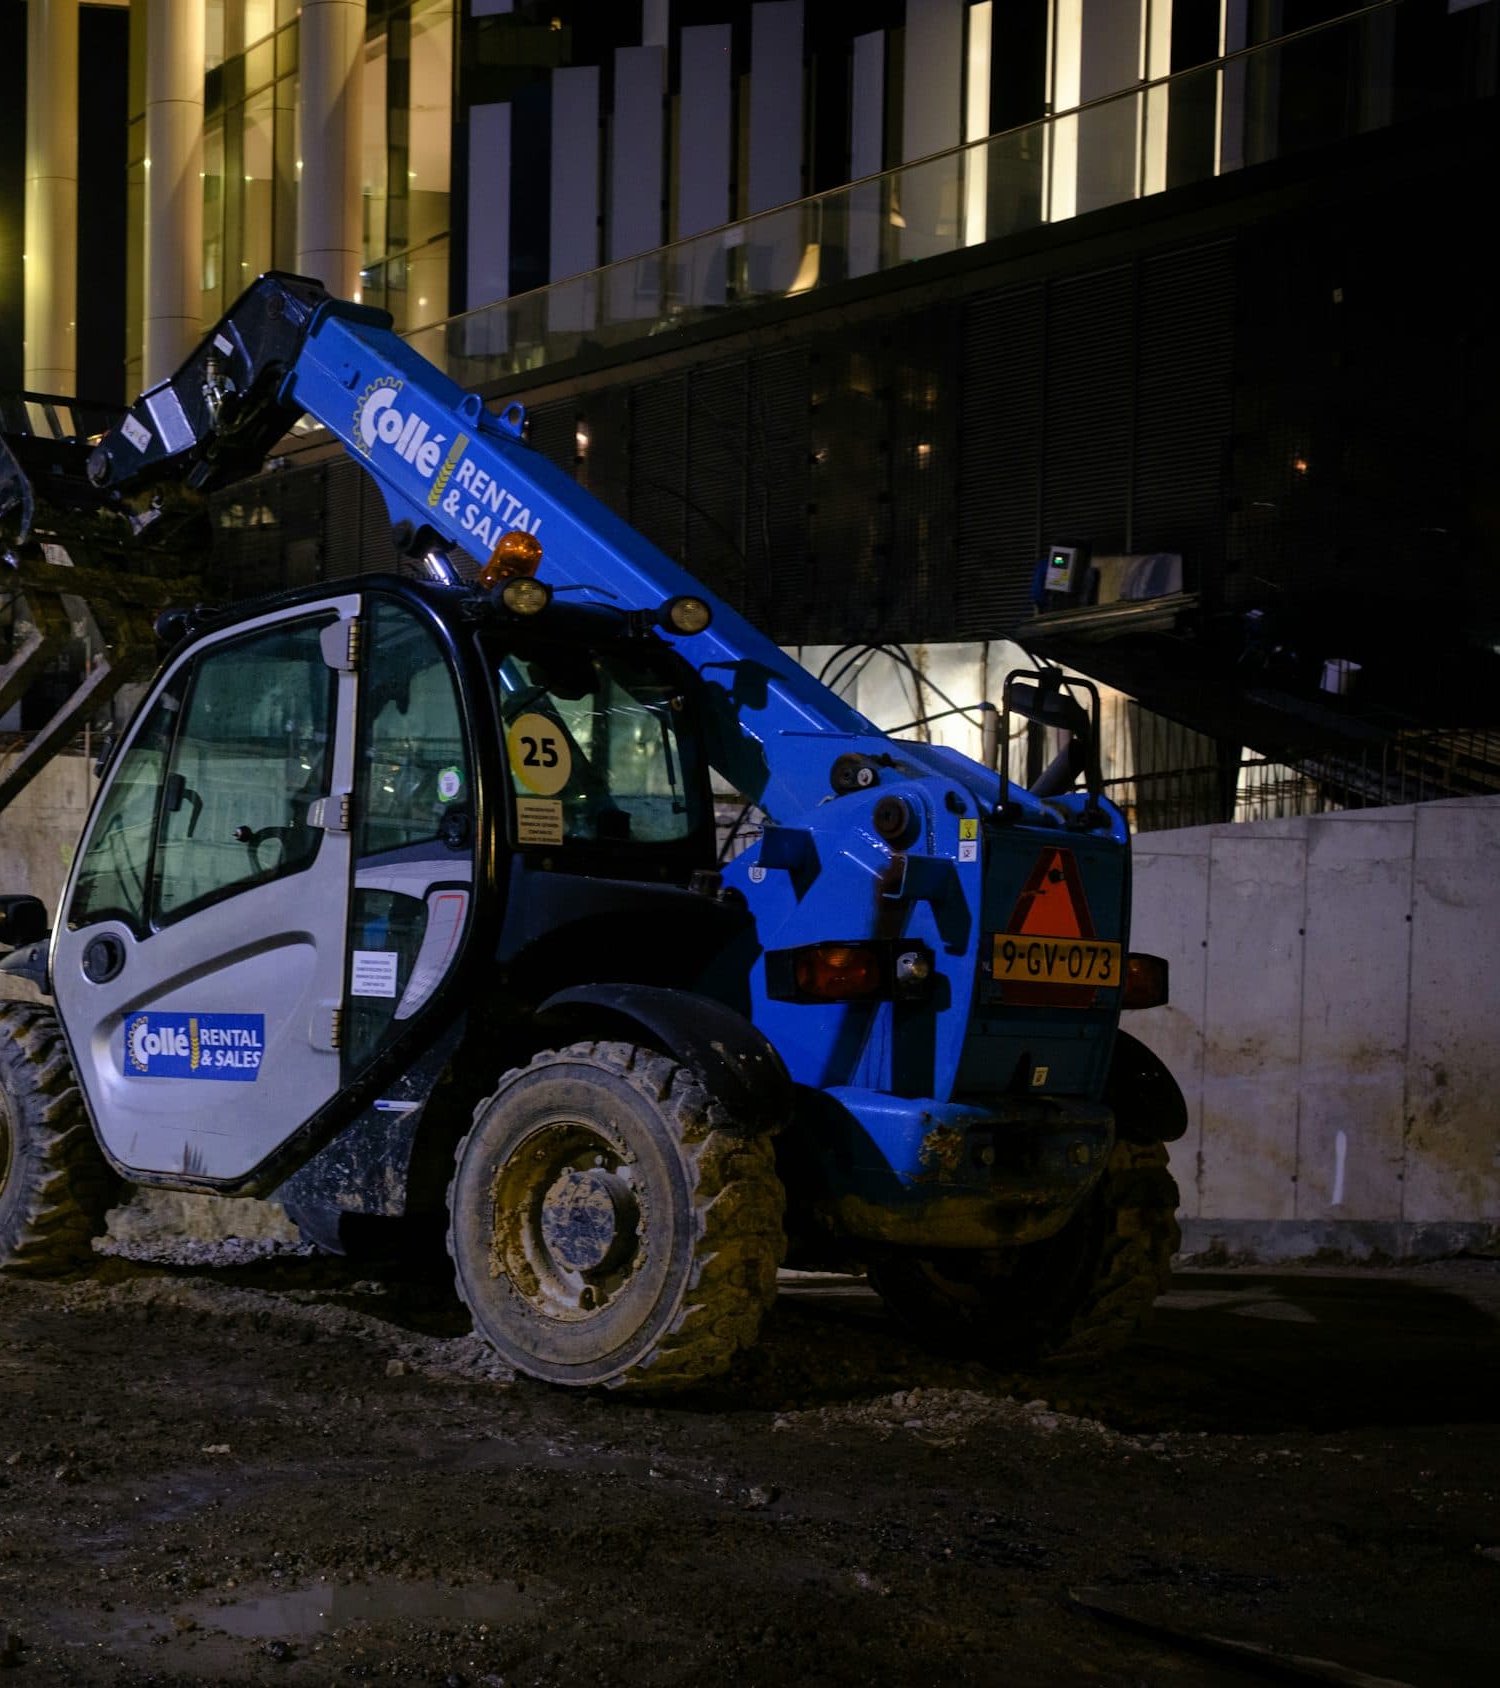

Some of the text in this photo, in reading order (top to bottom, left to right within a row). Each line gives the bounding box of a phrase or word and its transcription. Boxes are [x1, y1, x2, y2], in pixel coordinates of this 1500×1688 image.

[360, 387, 447, 478] Collé
[442, 489, 461, 518] &
[520, 736, 558, 768] 25
[1002, 940, 1112, 980] 9-GV-073
[132, 1023, 189, 1065] Collé
[200, 1028, 262, 1047] RENTAL
[200, 1049, 261, 1068] & SALES
